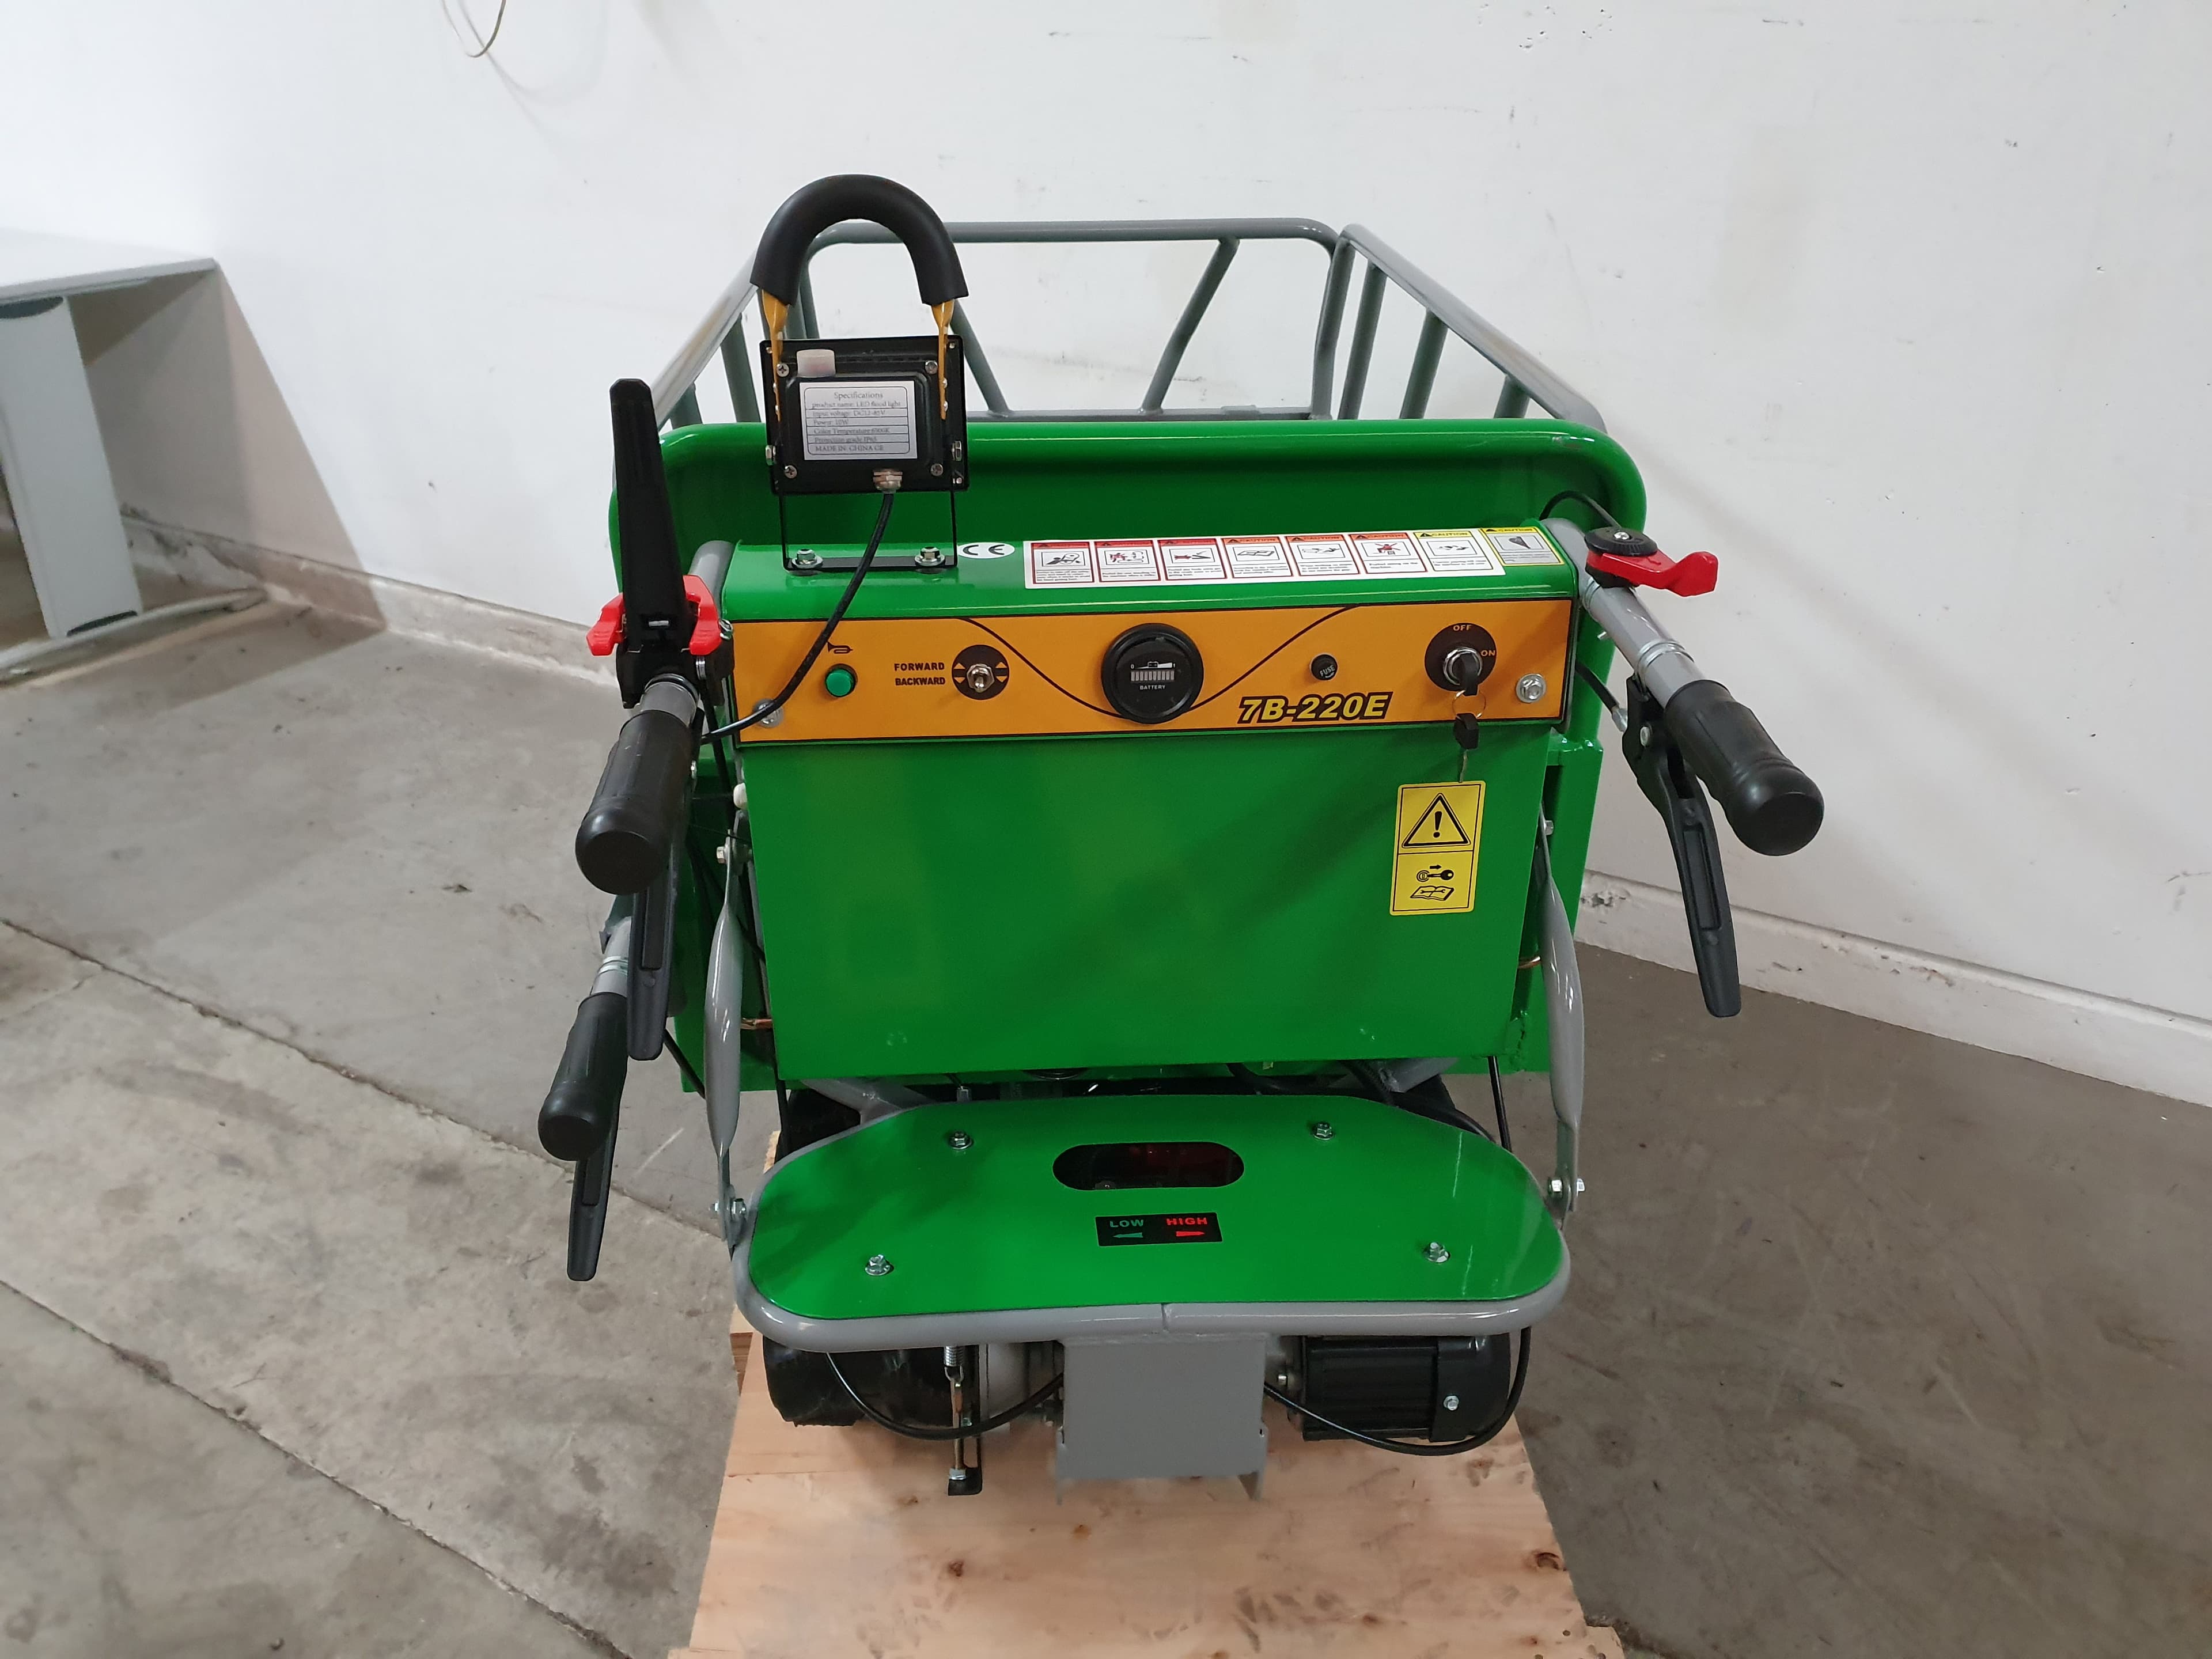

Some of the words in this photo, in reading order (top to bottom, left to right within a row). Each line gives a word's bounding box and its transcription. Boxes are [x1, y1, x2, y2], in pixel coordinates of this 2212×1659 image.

[834, 392, 884, 401] Specifications
[963, 544, 1005, 556] CE
[894, 662, 945, 672] FORWARD
[1319, 664, 1336, 677] FUSE
[895, 677, 946, 686] BACKWARD
[1238, 691, 1393, 724] 7B-220E
[1109, 1219, 1144, 1228] LOW
[1166, 1217, 1207, 1225] HIGH
